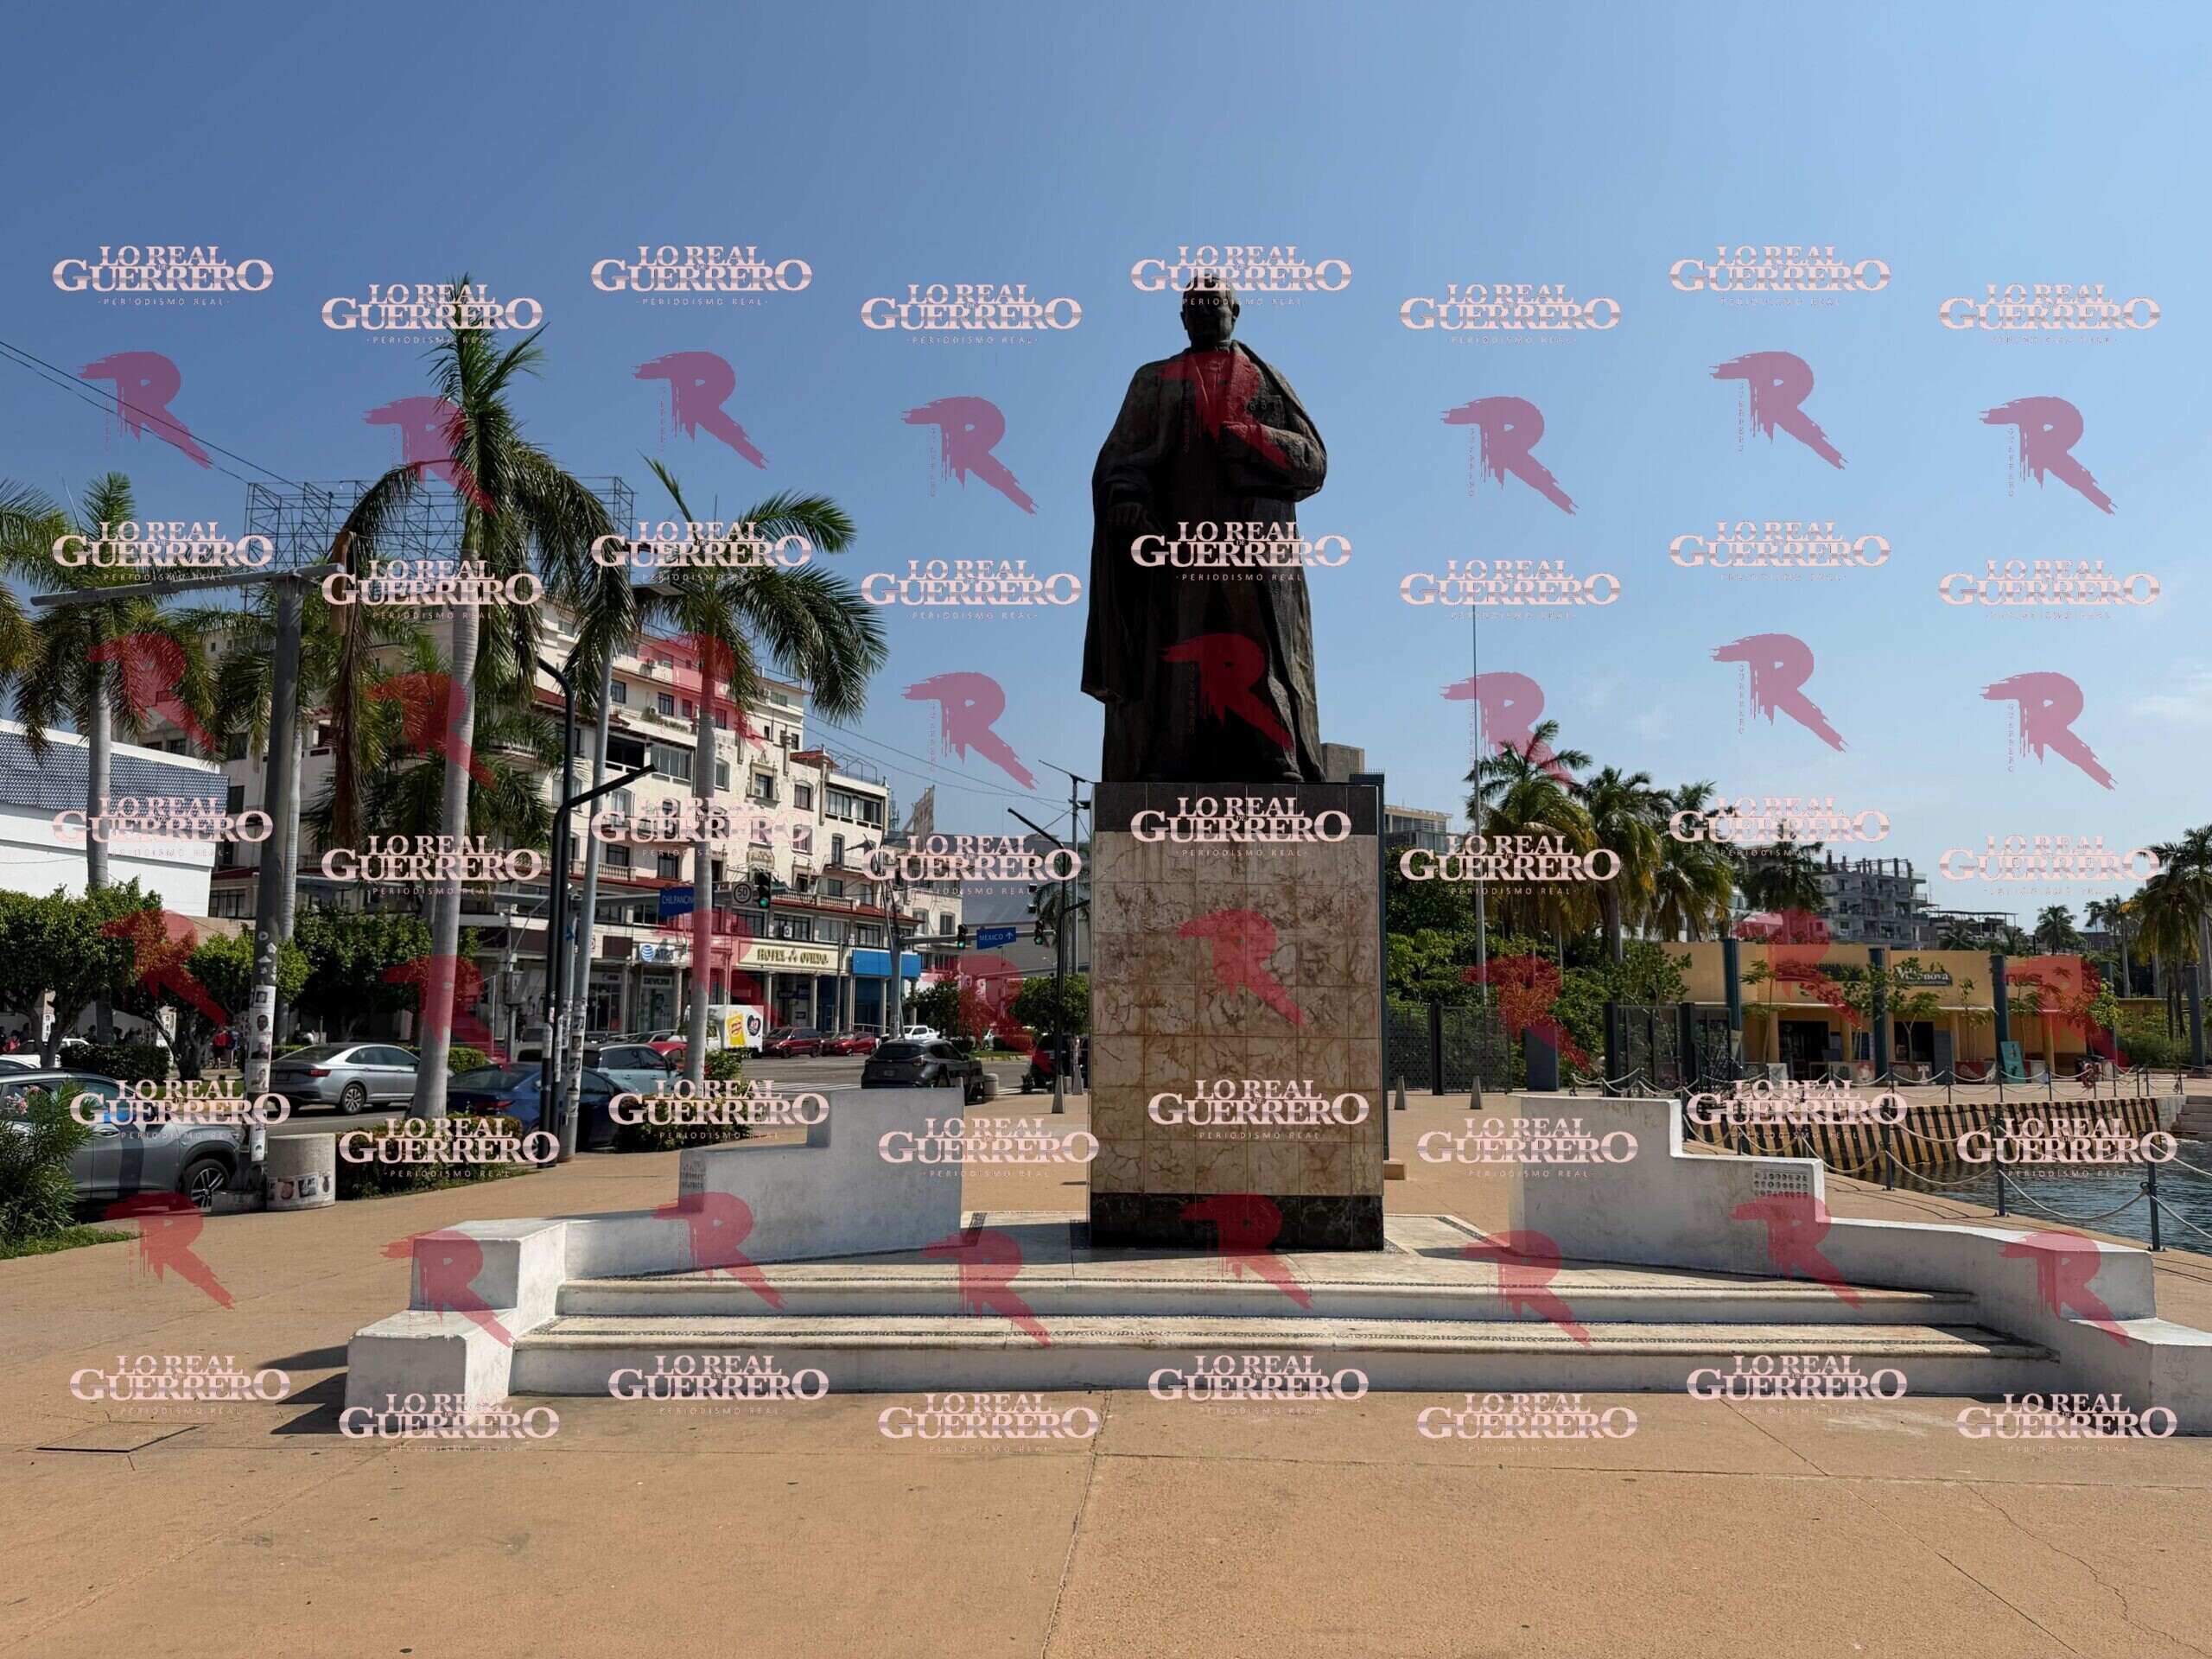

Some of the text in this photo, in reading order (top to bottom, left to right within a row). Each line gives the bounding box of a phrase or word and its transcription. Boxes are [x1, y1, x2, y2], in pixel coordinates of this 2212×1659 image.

[738, 887, 748, 897] 50
[661, 894, 693, 905] CHILPANCIN
[757, 948, 785, 962] HOTEL
